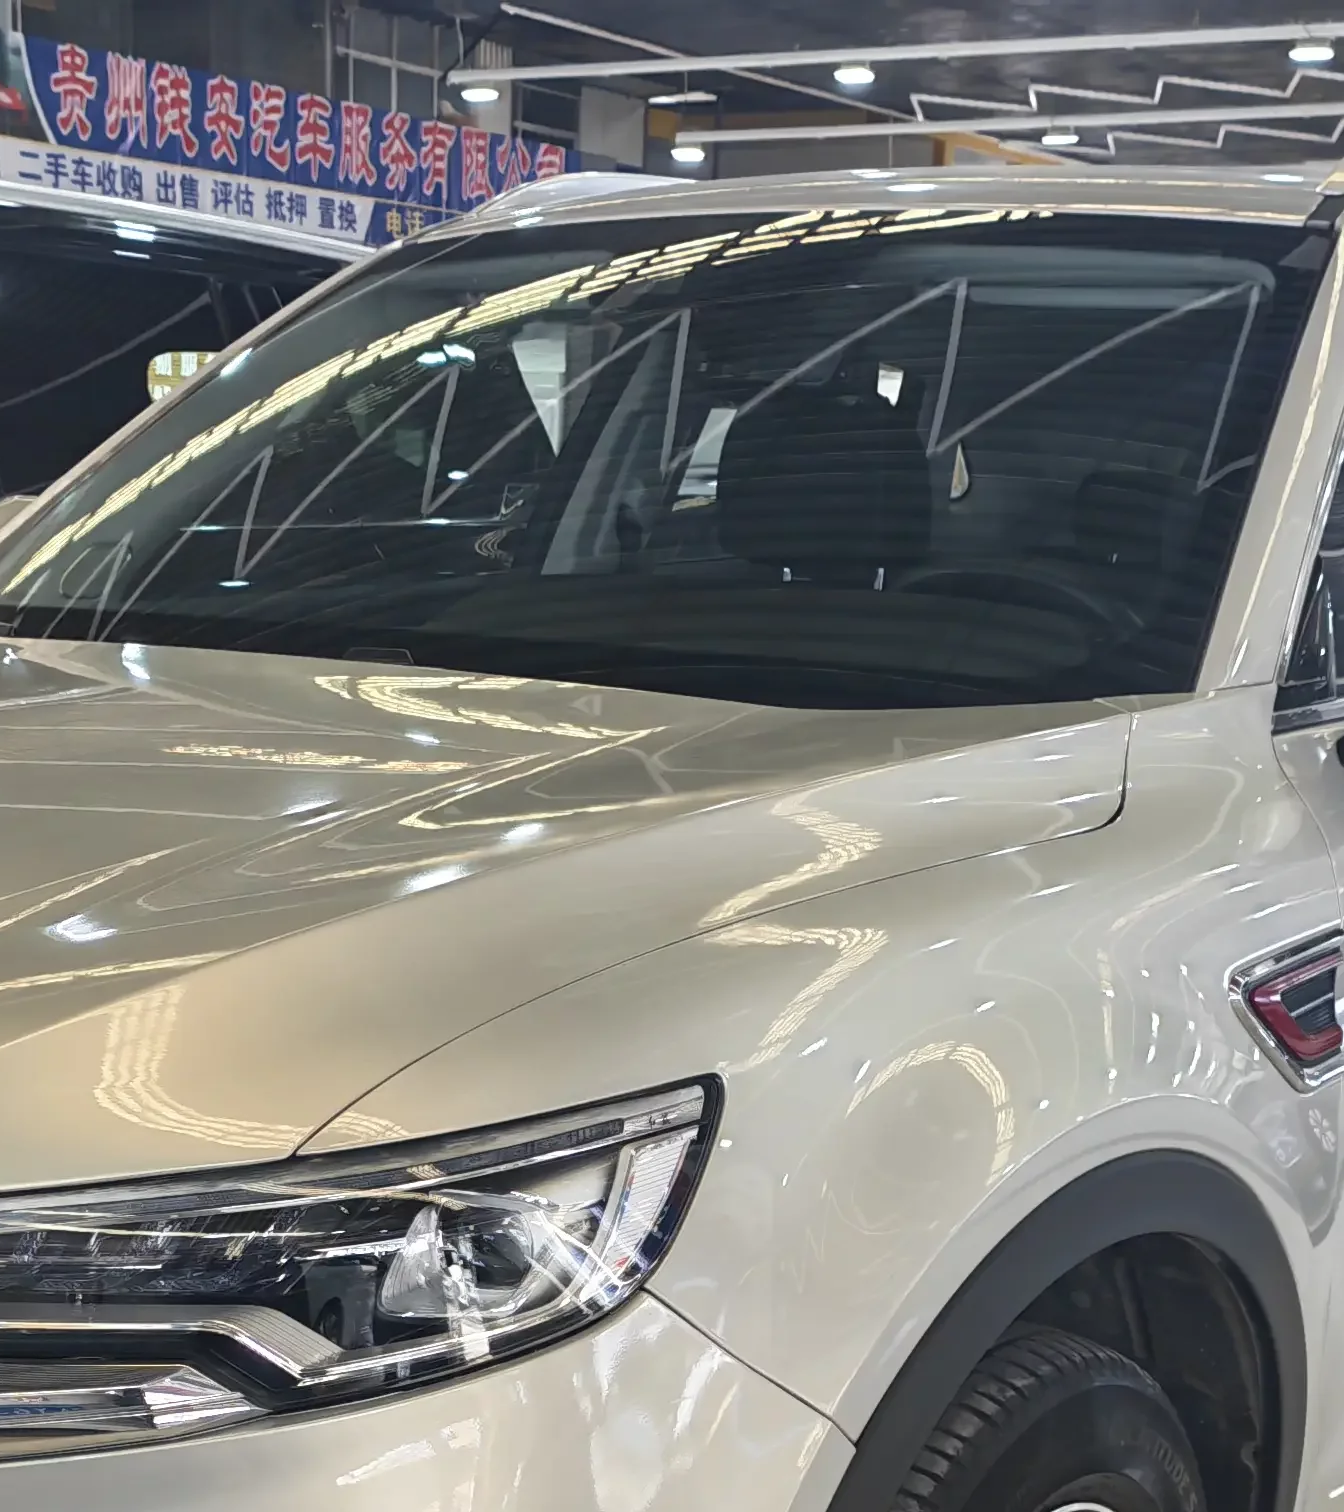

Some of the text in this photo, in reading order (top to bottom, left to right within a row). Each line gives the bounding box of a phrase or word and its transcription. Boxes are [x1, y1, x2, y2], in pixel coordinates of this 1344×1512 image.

[17, 150, 144, 201] 二手车收购
[156, 170, 200, 210] 出售
[211, 178, 255, 218] 评估
[265, 186, 308, 226] 抵押
[317, 196, 357, 233] 置换
